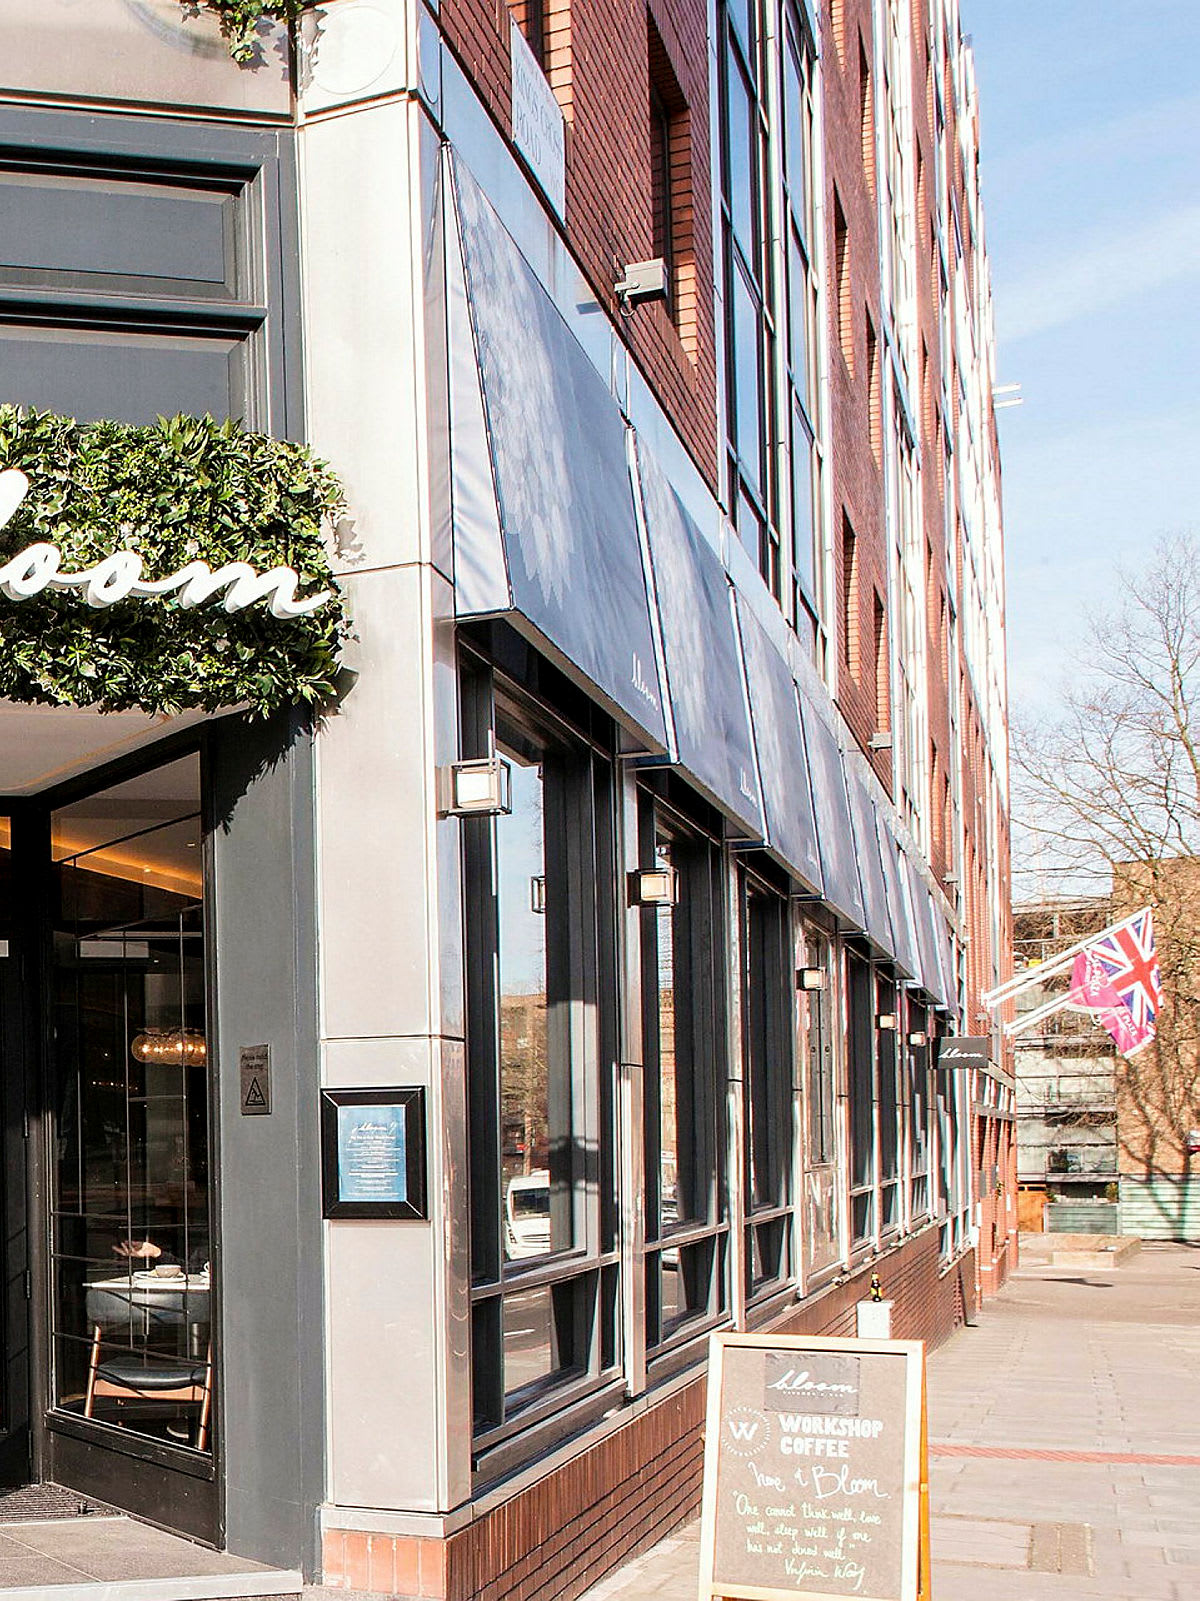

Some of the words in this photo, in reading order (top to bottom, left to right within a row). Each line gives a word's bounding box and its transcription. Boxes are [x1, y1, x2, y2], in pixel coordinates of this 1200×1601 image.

[937, 1048, 983, 1059] bloom
[766, 1369, 859, 1394] bloom
[778, 1415, 884, 1439] WORKSHOP
[780, 1436, 850, 1458] COFFEE
